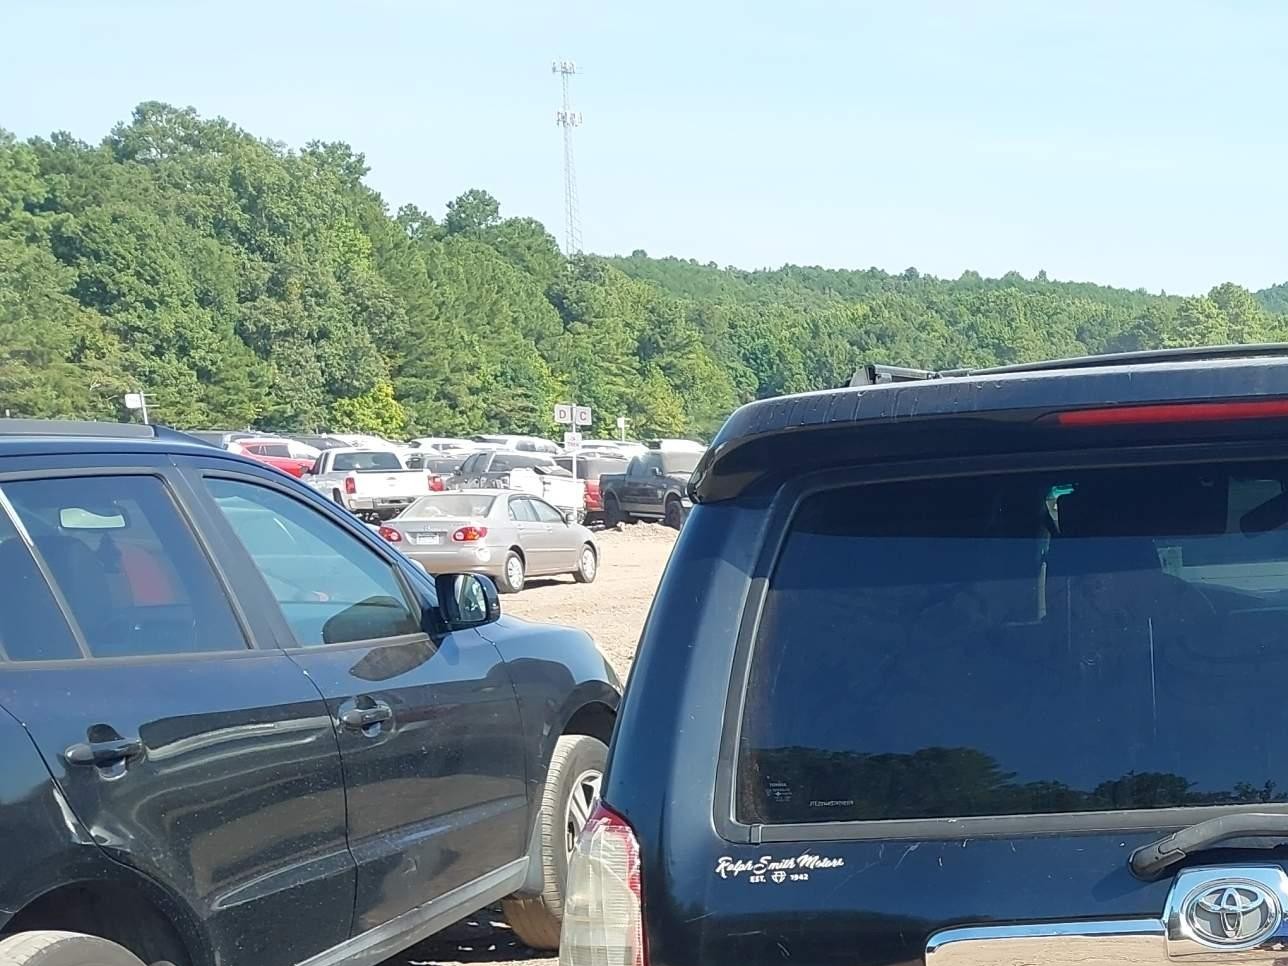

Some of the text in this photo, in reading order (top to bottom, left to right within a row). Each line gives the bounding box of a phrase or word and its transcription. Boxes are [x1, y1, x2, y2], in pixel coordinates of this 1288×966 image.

[715, 854, 845, 879] Ralph Smith Motors
